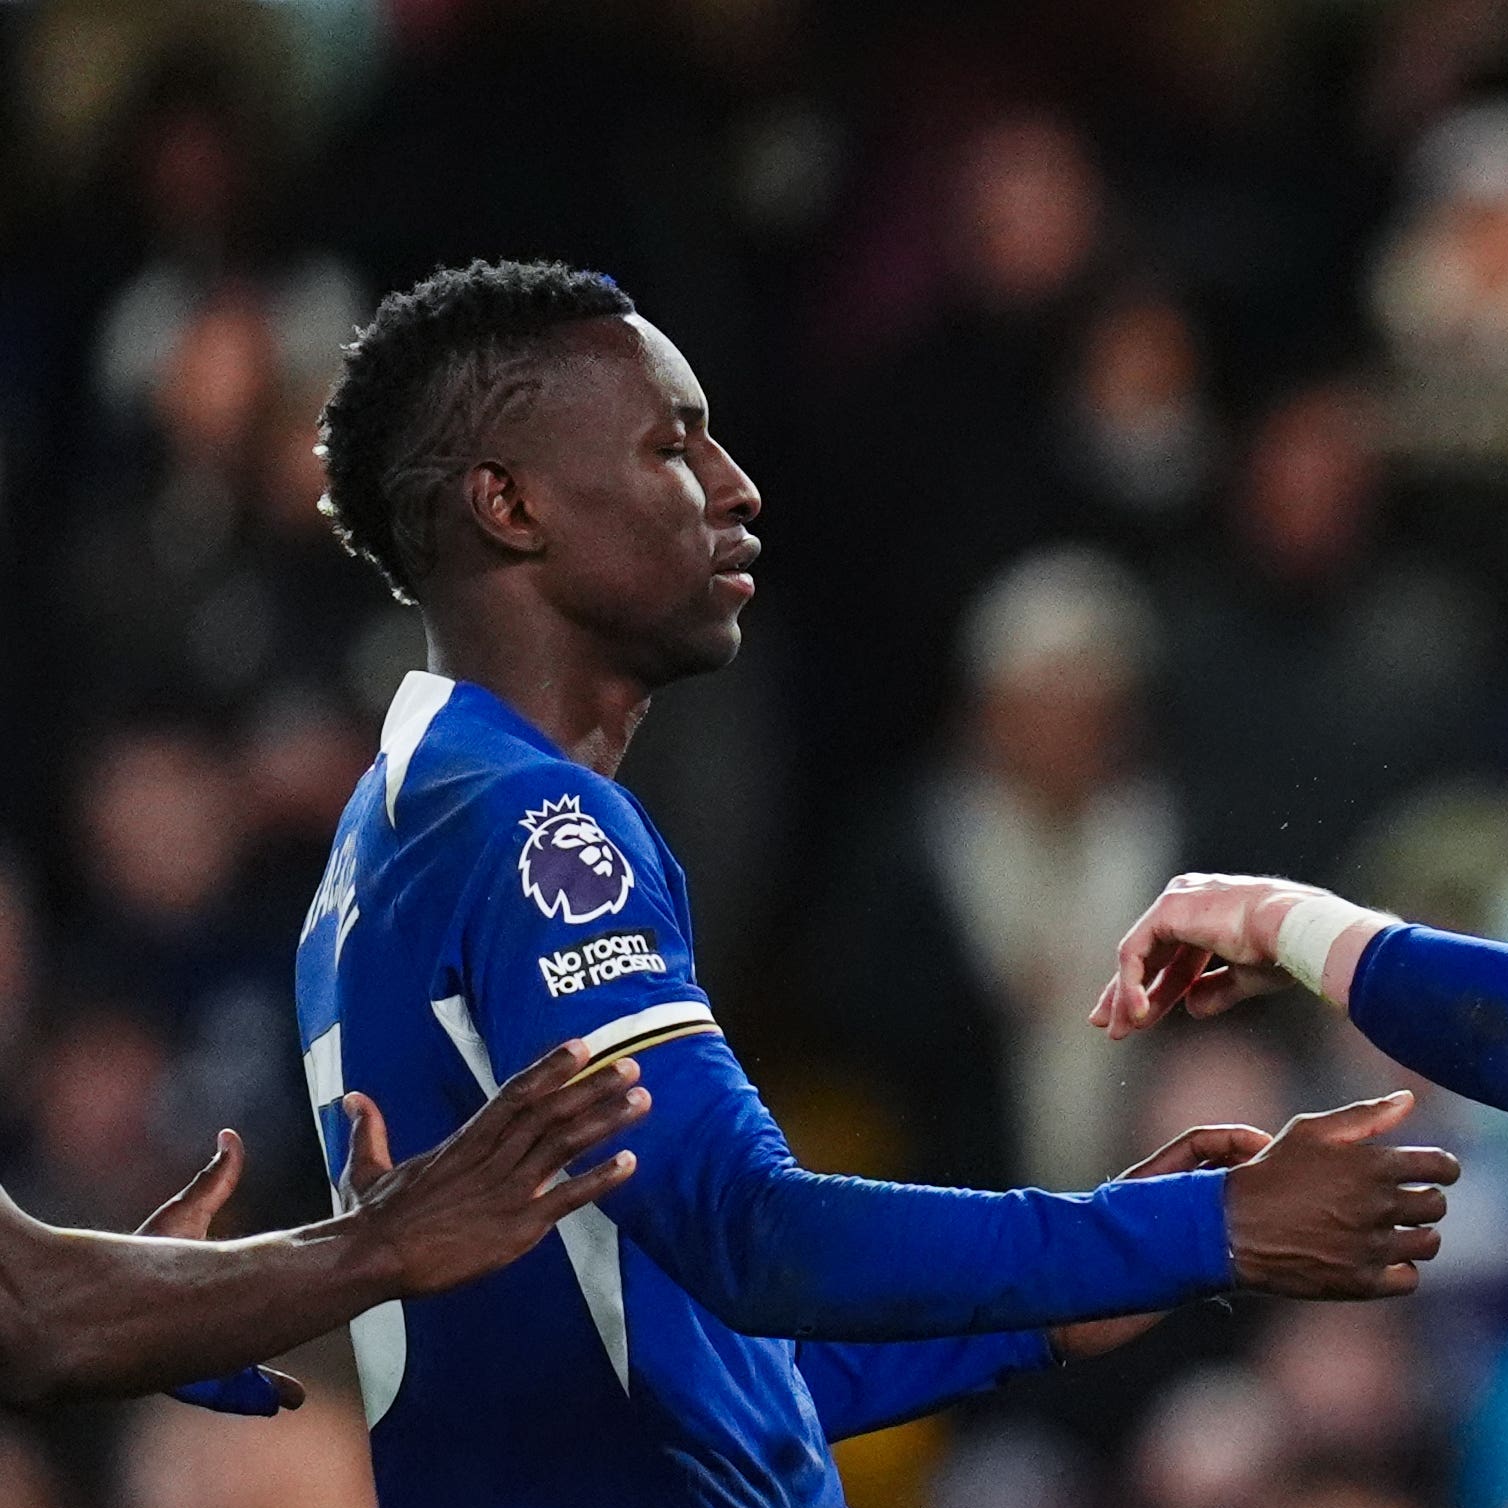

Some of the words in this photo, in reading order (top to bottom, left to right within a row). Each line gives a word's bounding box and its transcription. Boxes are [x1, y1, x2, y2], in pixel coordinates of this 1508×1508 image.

[538, 951, 582, 981] No
[582, 934, 650, 965] room
[547, 969, 587, 998] for
[588, 953, 667, 986] racism
